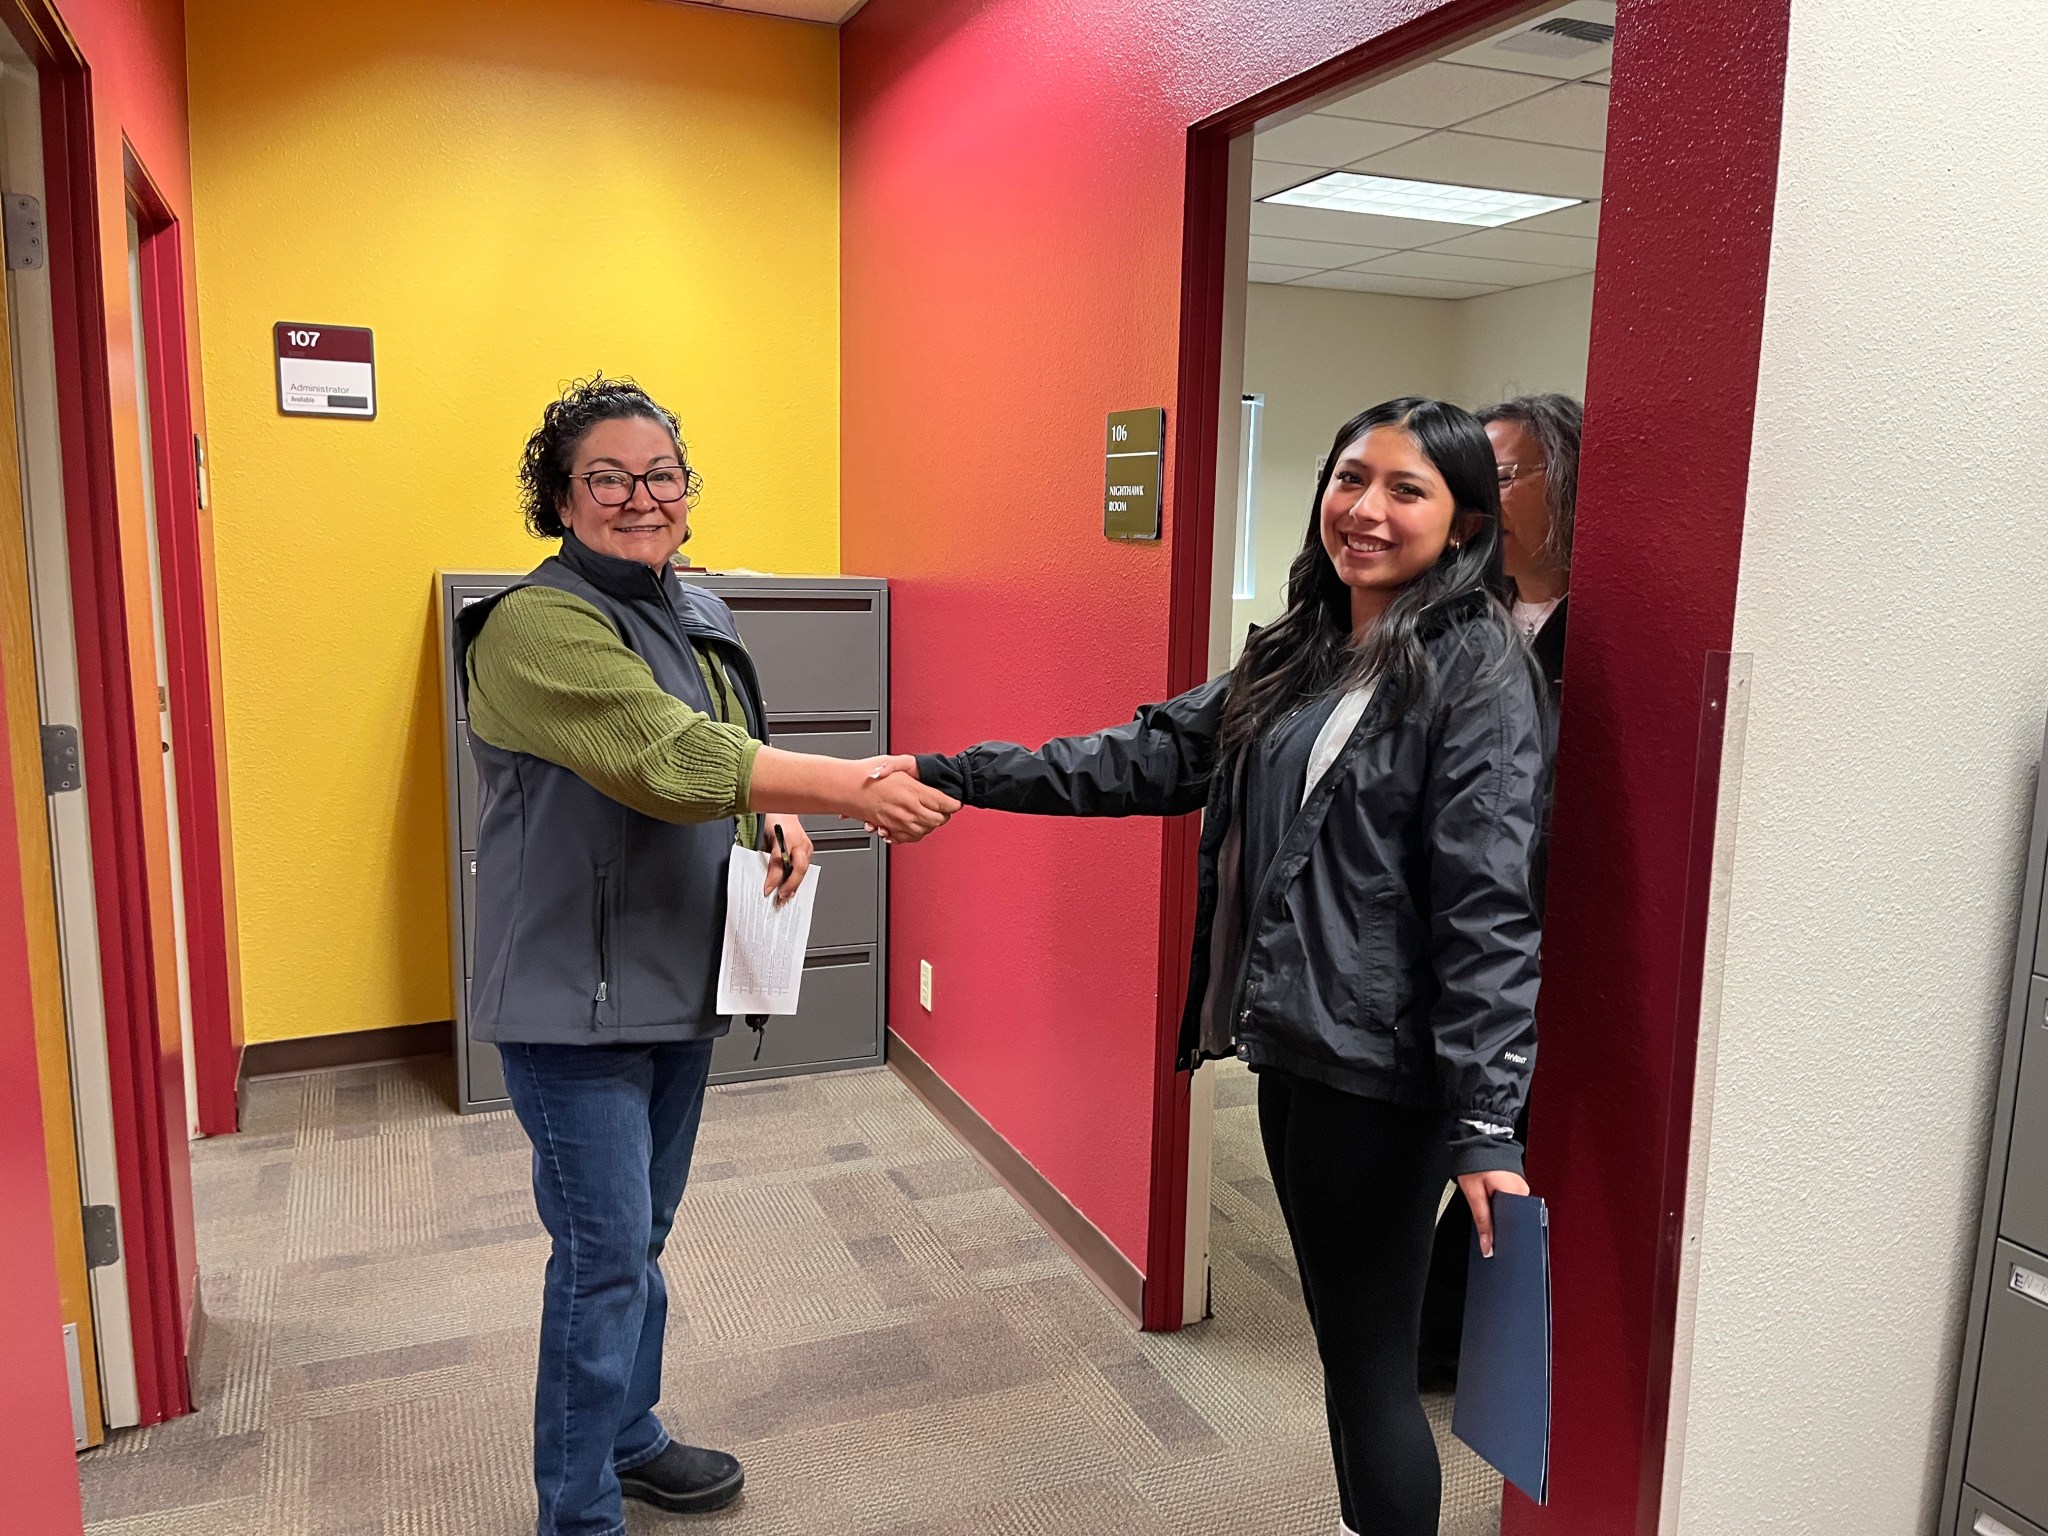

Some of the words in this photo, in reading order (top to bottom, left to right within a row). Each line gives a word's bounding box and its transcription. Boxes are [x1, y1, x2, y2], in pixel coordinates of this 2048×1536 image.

[287, 330, 320, 347] 107
[290, 383, 349, 394] Administrator
[1111, 424, 1128, 442] 106
[1109, 485, 1144, 496] NIGHTHAWK
[1108, 501, 1127, 512] ROOM
